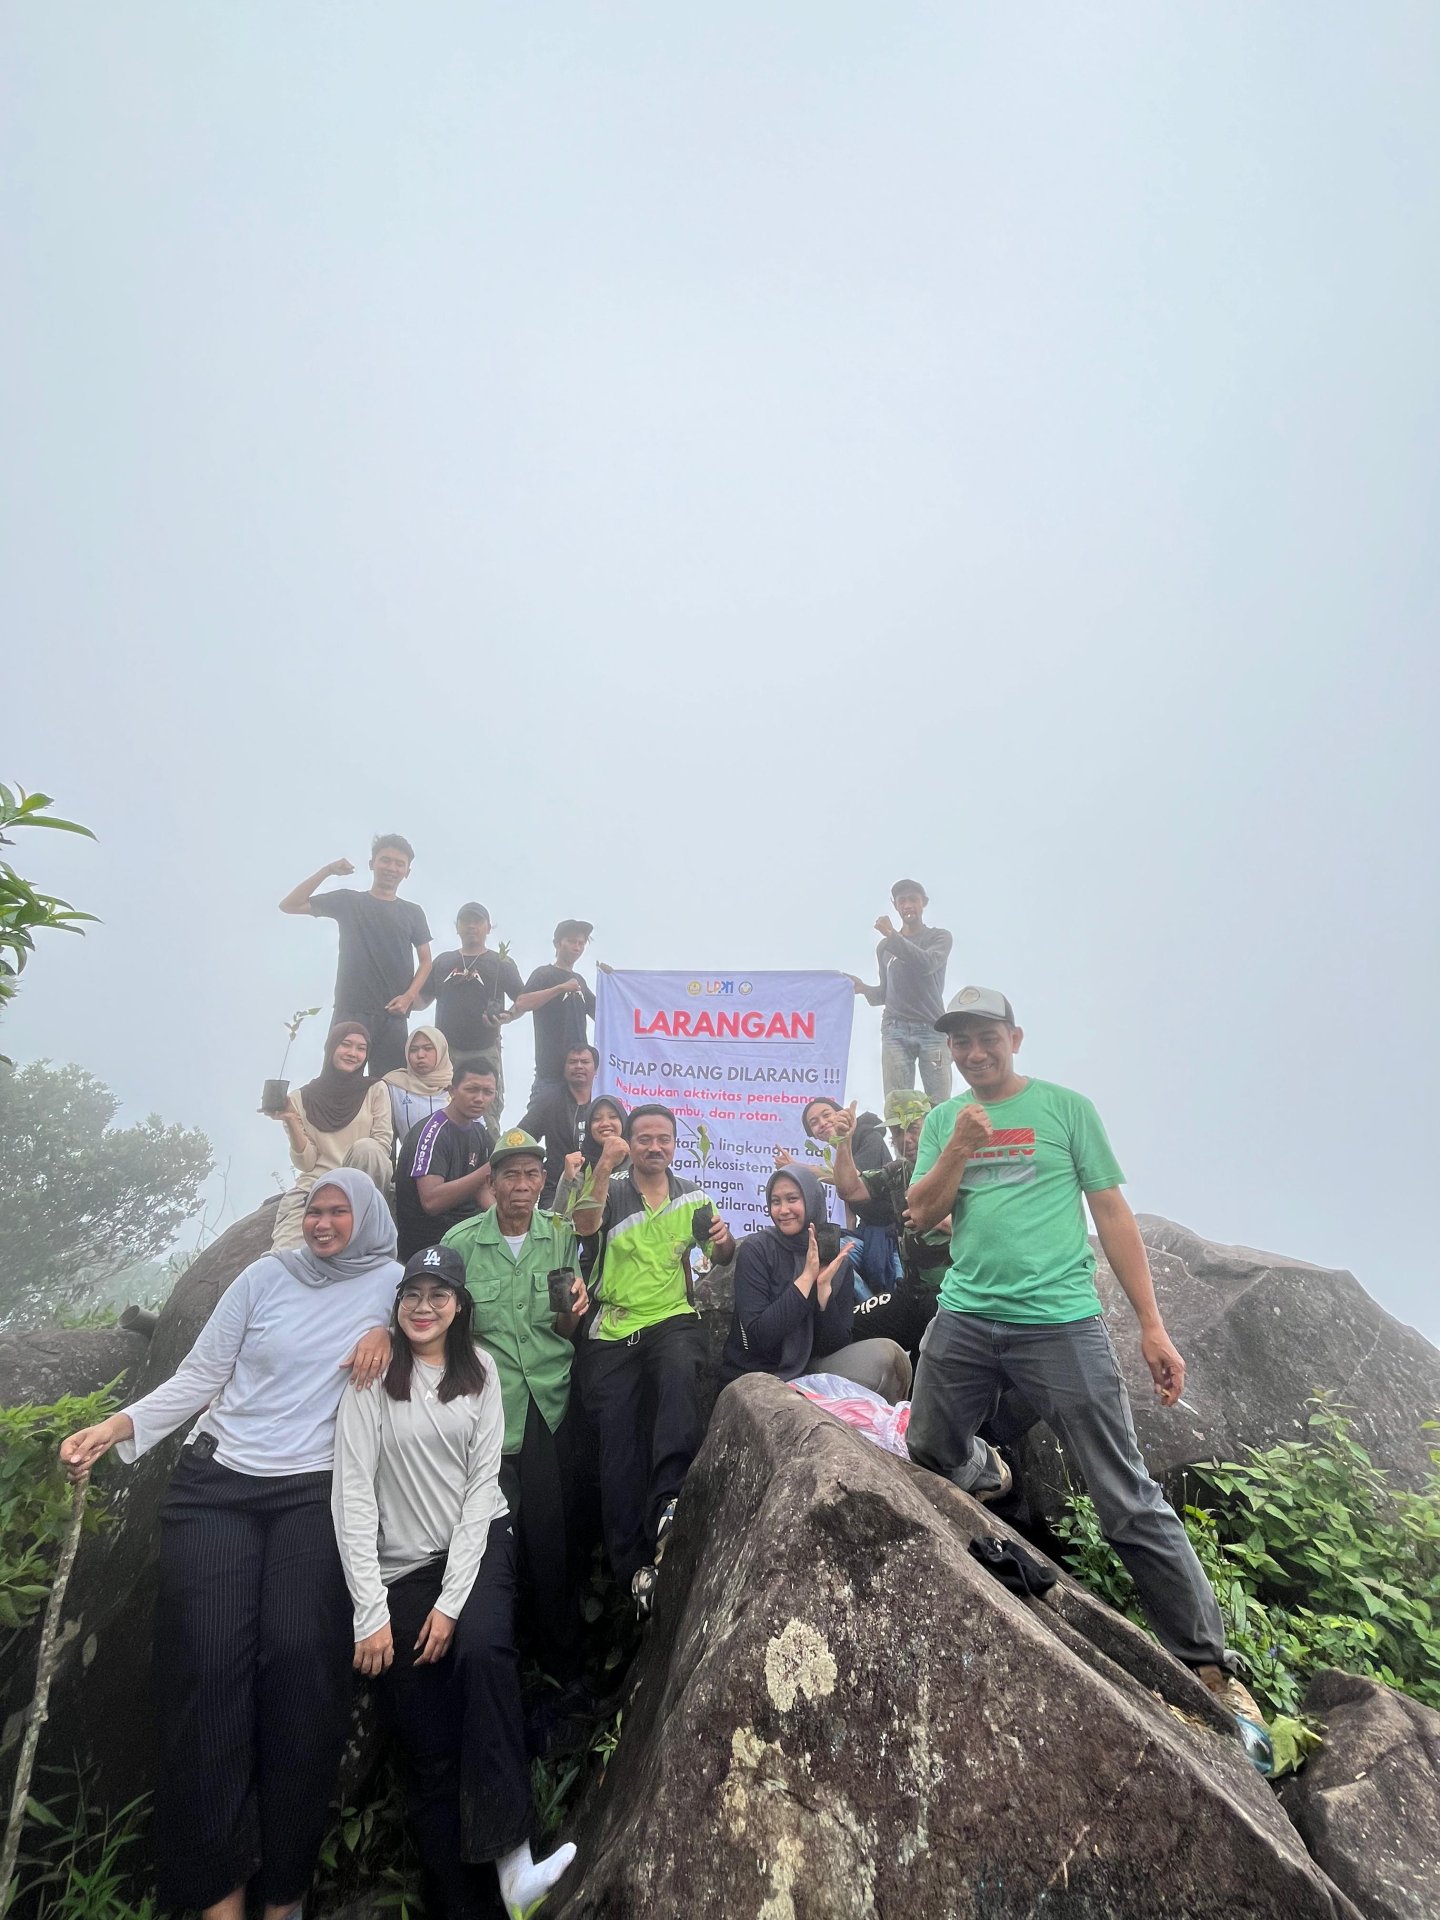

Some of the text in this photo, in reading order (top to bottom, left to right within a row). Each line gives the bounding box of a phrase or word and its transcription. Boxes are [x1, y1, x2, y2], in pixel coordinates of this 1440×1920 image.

[634, 1008, 816, 1039] LARANGAN
[608, 1054, 657, 1077] SETIAP
[661, 1062, 723, 1080] ORANG
[728, 1066, 819, 1083] DILARANG
[684, 1087, 742, 1101] aktivitas
[709, 1107, 736, 1120] dan
[708, 1157, 773, 1173] ekosistem
[716, 1197, 771, 1217] dilarang
[423, 1248, 441, 1266] LA
